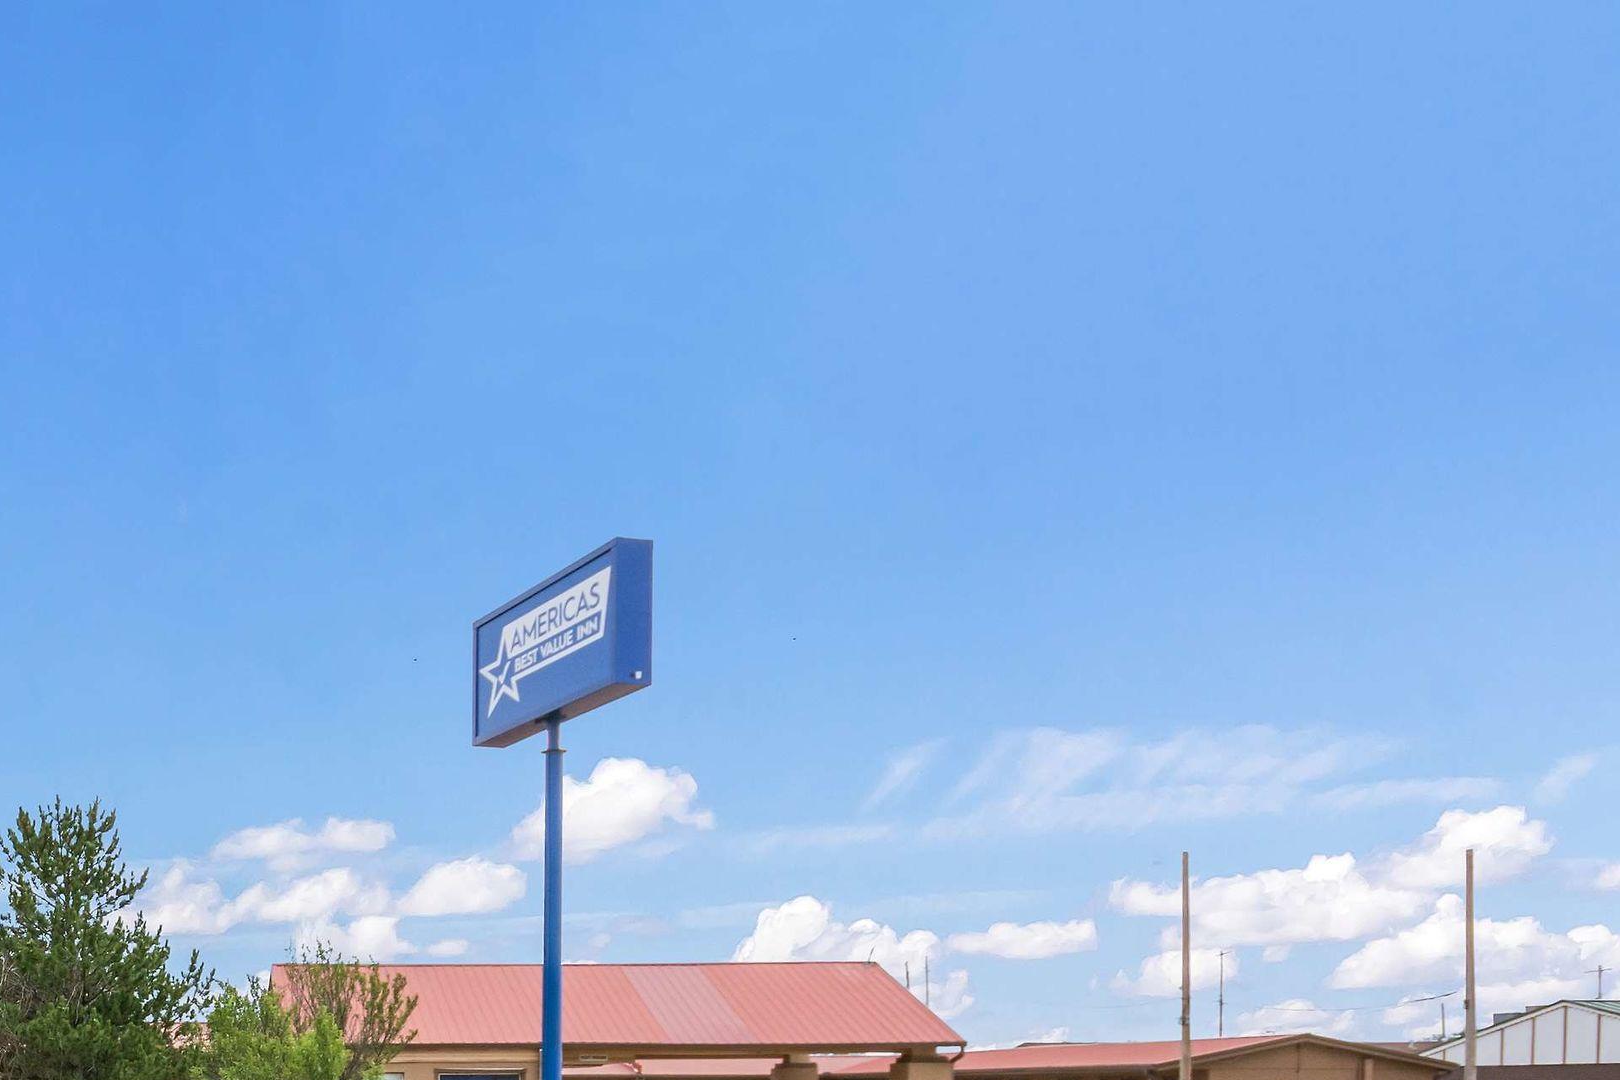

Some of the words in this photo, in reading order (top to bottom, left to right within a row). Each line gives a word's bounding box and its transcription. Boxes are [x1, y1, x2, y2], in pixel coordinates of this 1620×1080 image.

[511, 582, 600, 652] AMERICAS
[514, 648, 538, 673] BEST
[540, 629, 573, 658] VALUE
[577, 616, 598, 640] INN
